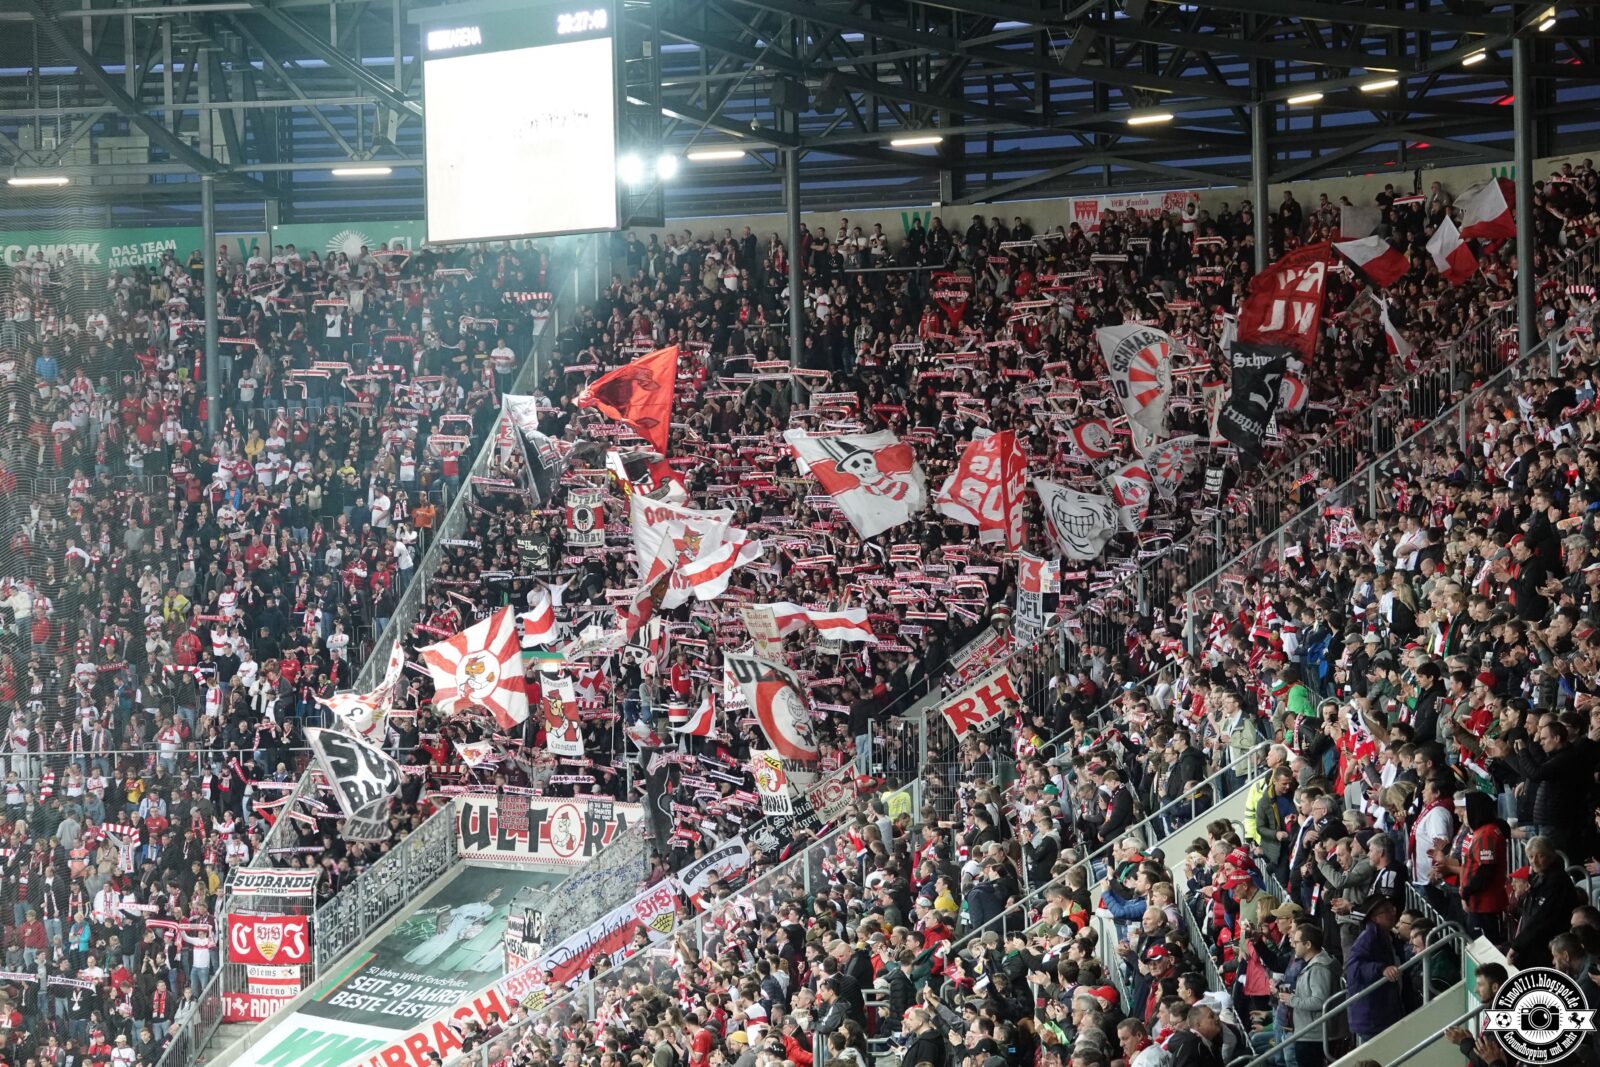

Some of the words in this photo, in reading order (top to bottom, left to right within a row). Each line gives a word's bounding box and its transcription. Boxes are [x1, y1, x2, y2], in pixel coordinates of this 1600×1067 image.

[112, 245, 138, 257] DAS
[140, 240, 177, 252] TEAM
[943, 674, 1021, 737] RH
[234, 874, 313, 888] SÜDBANDE
[366, 965, 379, 974] 50
[380, 968, 400, 979] Jahre
[400, 972, 424, 982] WWK
[347, 976, 390, 993] SEIT
[389, 982, 411, 998] 50
[406, 984, 473, 1004] JAHREN
[328, 991, 387, 1012] BESTE
